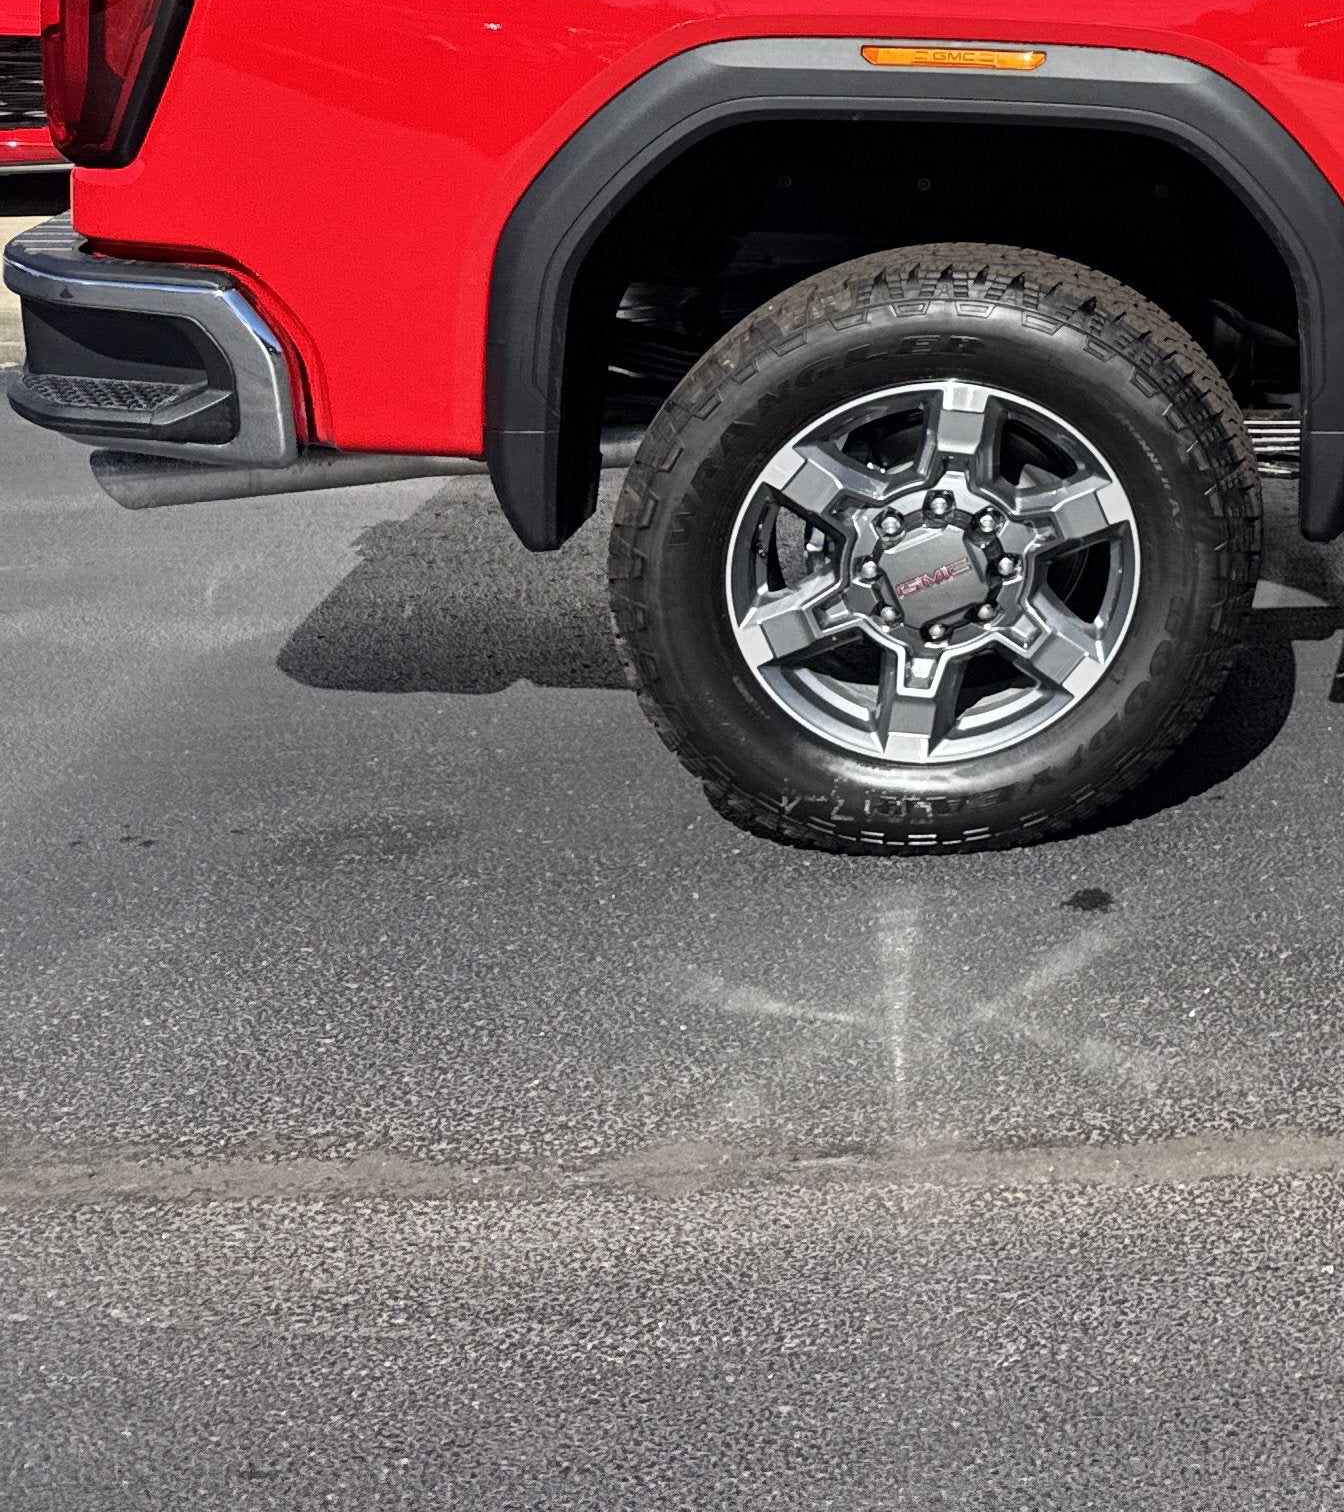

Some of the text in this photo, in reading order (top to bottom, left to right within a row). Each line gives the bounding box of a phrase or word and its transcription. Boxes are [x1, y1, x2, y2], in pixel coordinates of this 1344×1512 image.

[932, 51, 975, 62] GMC
[666, 333, 987, 552] WRANGLER
[896, 557, 972, 600] GMC
